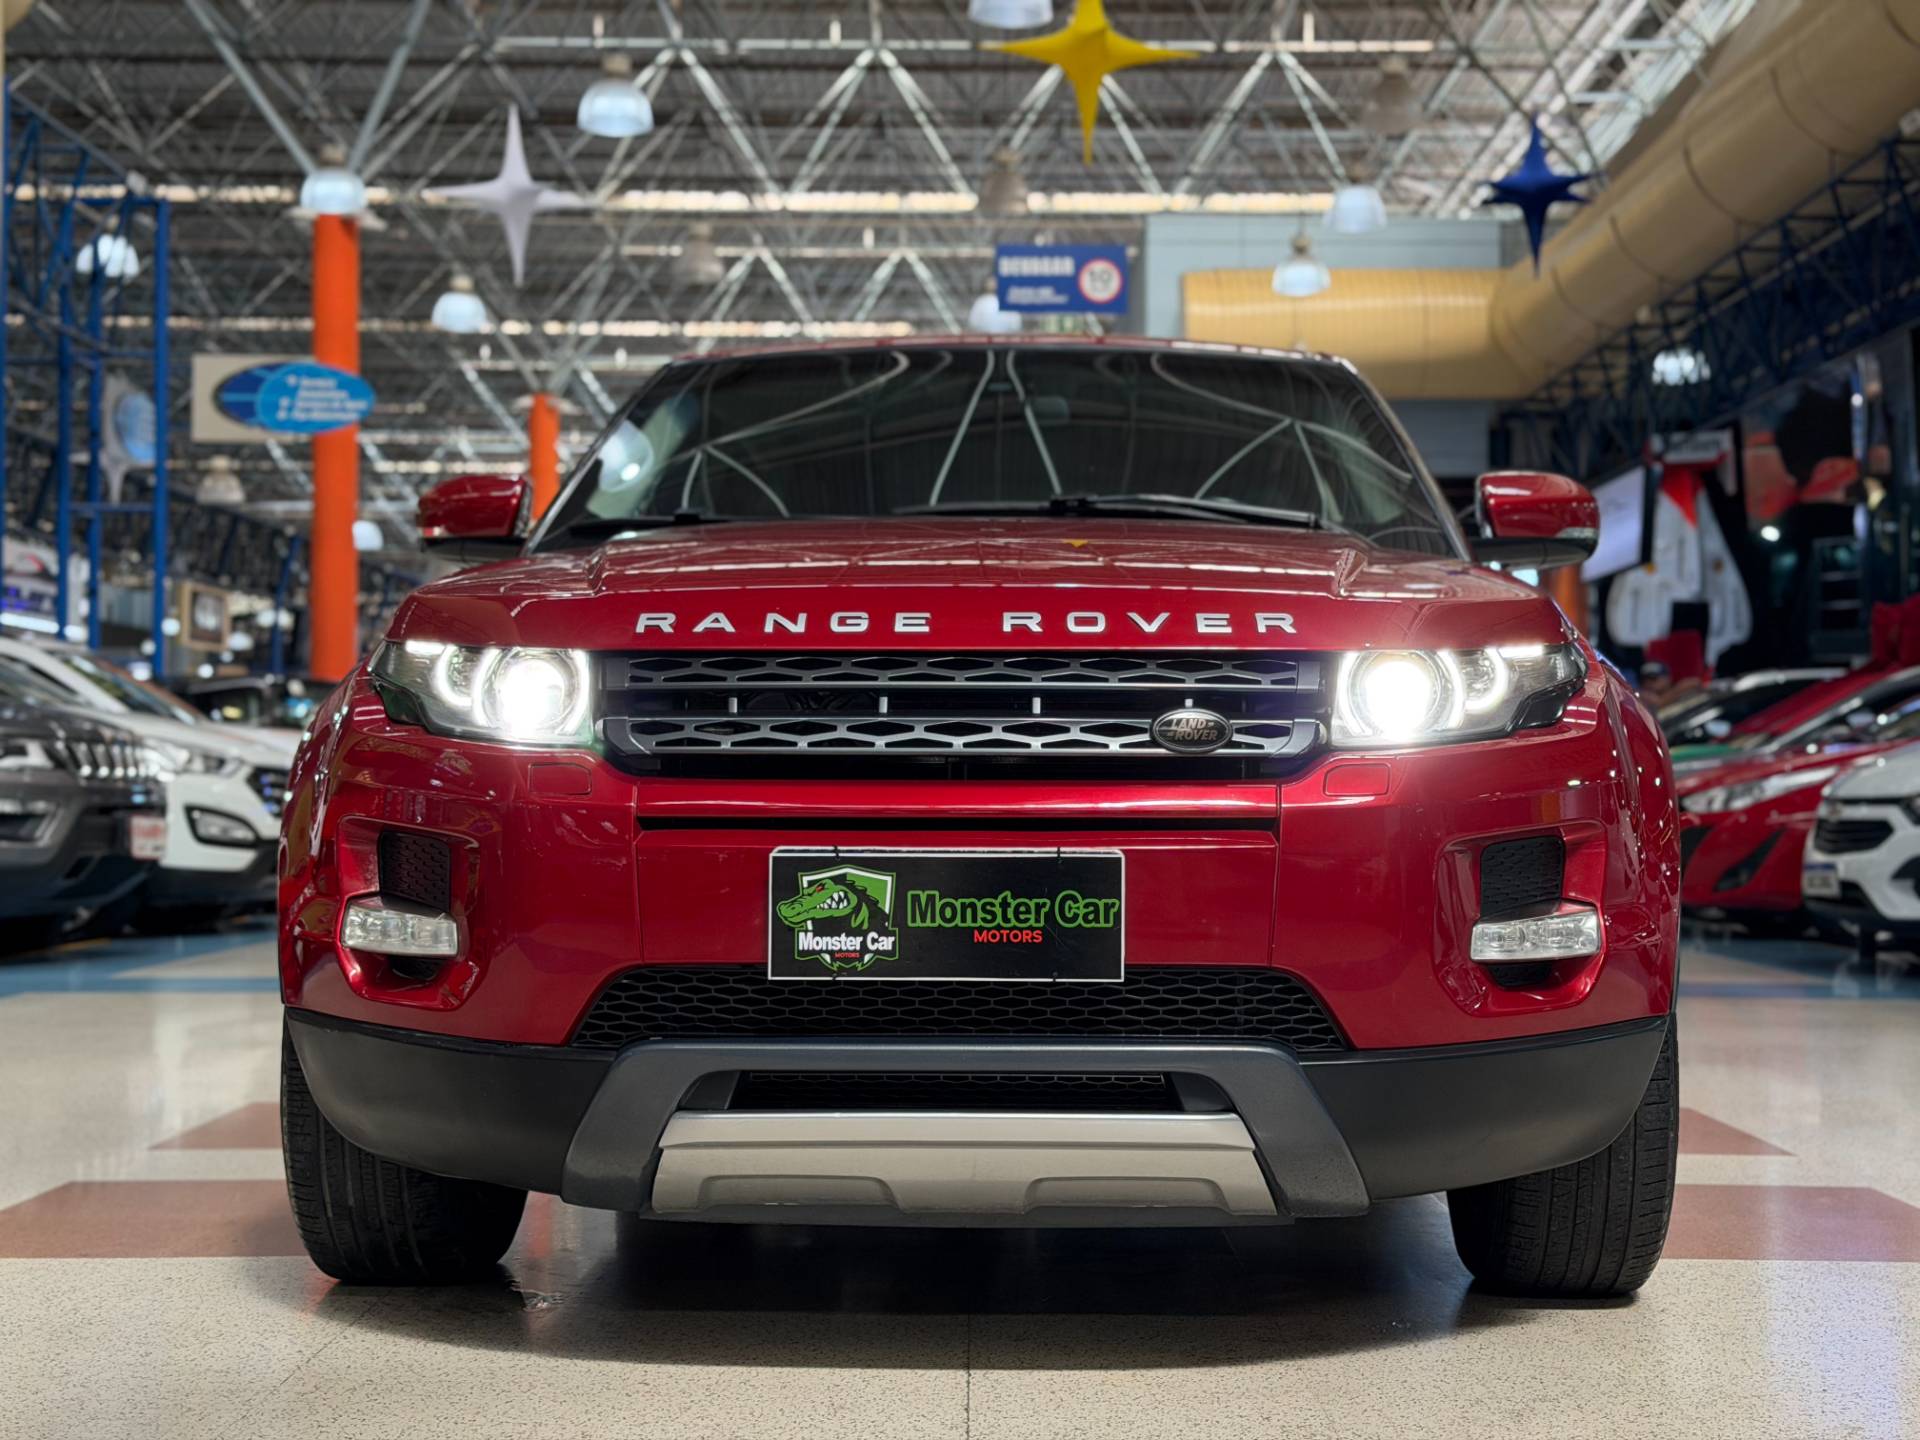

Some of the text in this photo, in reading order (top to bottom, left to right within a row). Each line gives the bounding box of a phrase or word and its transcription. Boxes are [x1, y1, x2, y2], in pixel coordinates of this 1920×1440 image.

[635, 612, 1297, 633] RANGE ROVER
[1171, 718, 1206, 729] LAND
[1175, 729, 1217, 740] ROVER
[907, 890, 1120, 927] Monster Car
[799, 931, 895, 951] Monster Car
[973, 929, 1043, 943] MOTORS
